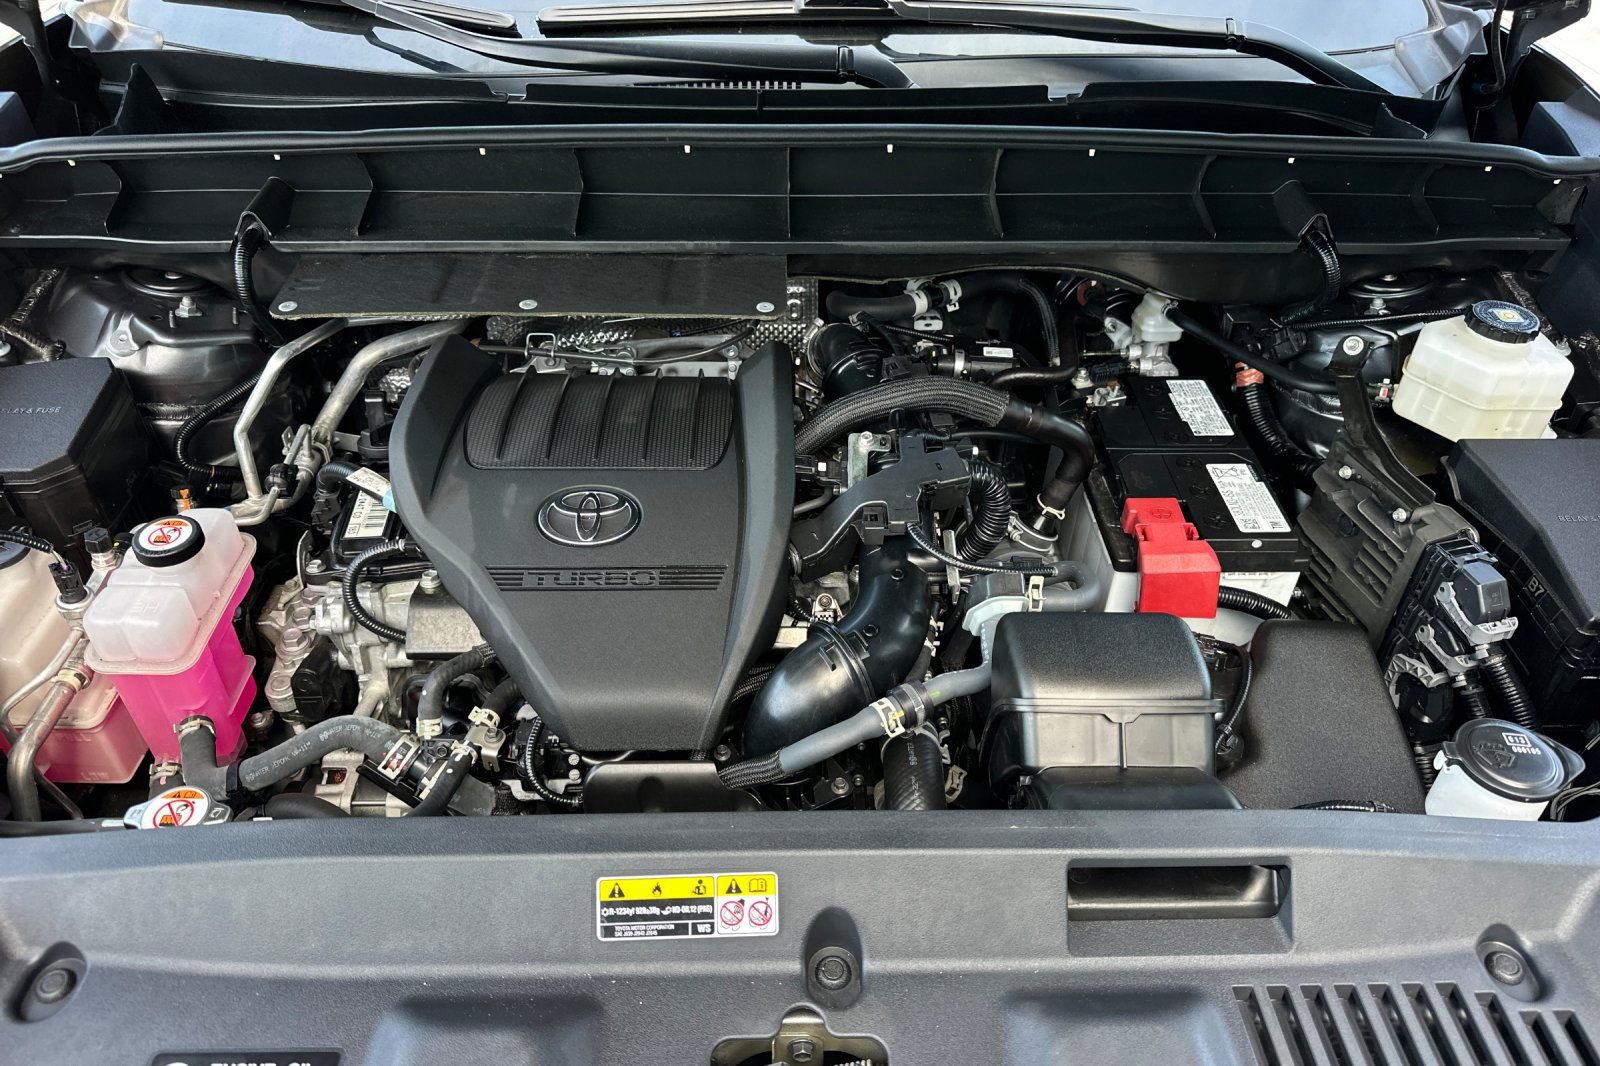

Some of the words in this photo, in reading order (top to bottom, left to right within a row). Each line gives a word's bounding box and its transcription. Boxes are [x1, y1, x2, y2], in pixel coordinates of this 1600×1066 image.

[36, 406, 62, 414] FUSE
[527, 571, 656, 587] TURBO
[1527, 576, 1545, 597] B7
[697, 924, 712, 933] WS
